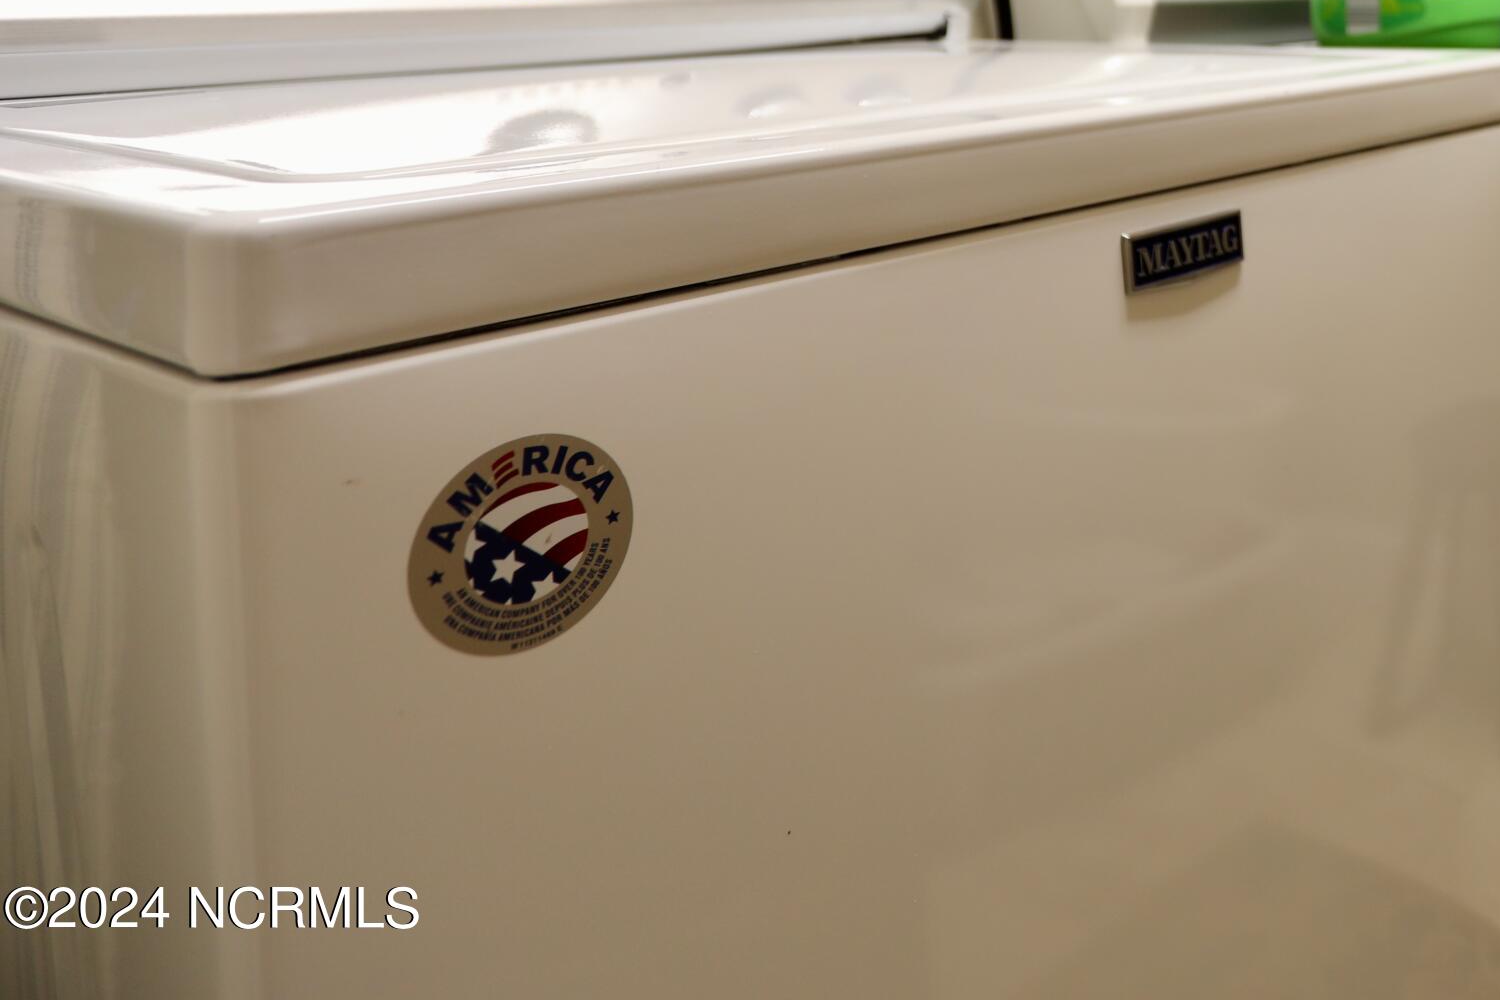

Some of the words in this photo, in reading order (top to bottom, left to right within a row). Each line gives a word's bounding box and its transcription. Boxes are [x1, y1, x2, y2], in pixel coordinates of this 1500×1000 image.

[1135, 223, 1239, 278] MAYTAG
[426, 445, 615, 553] AMERICA
[464, 595, 500, 618] AMERICAN
[502, 604, 541, 619] COMPANY
[542, 595, 558, 609] FOR
[558, 580, 577, 599] OVER
[584, 543, 599, 567] YEARS
[545, 596, 573, 618] DEPUIS
[572, 579, 590, 598] PLUS
[587, 568, 599, 579] DE
[601, 538, 611, 553] ANS
[579, 591, 591, 604] DE
